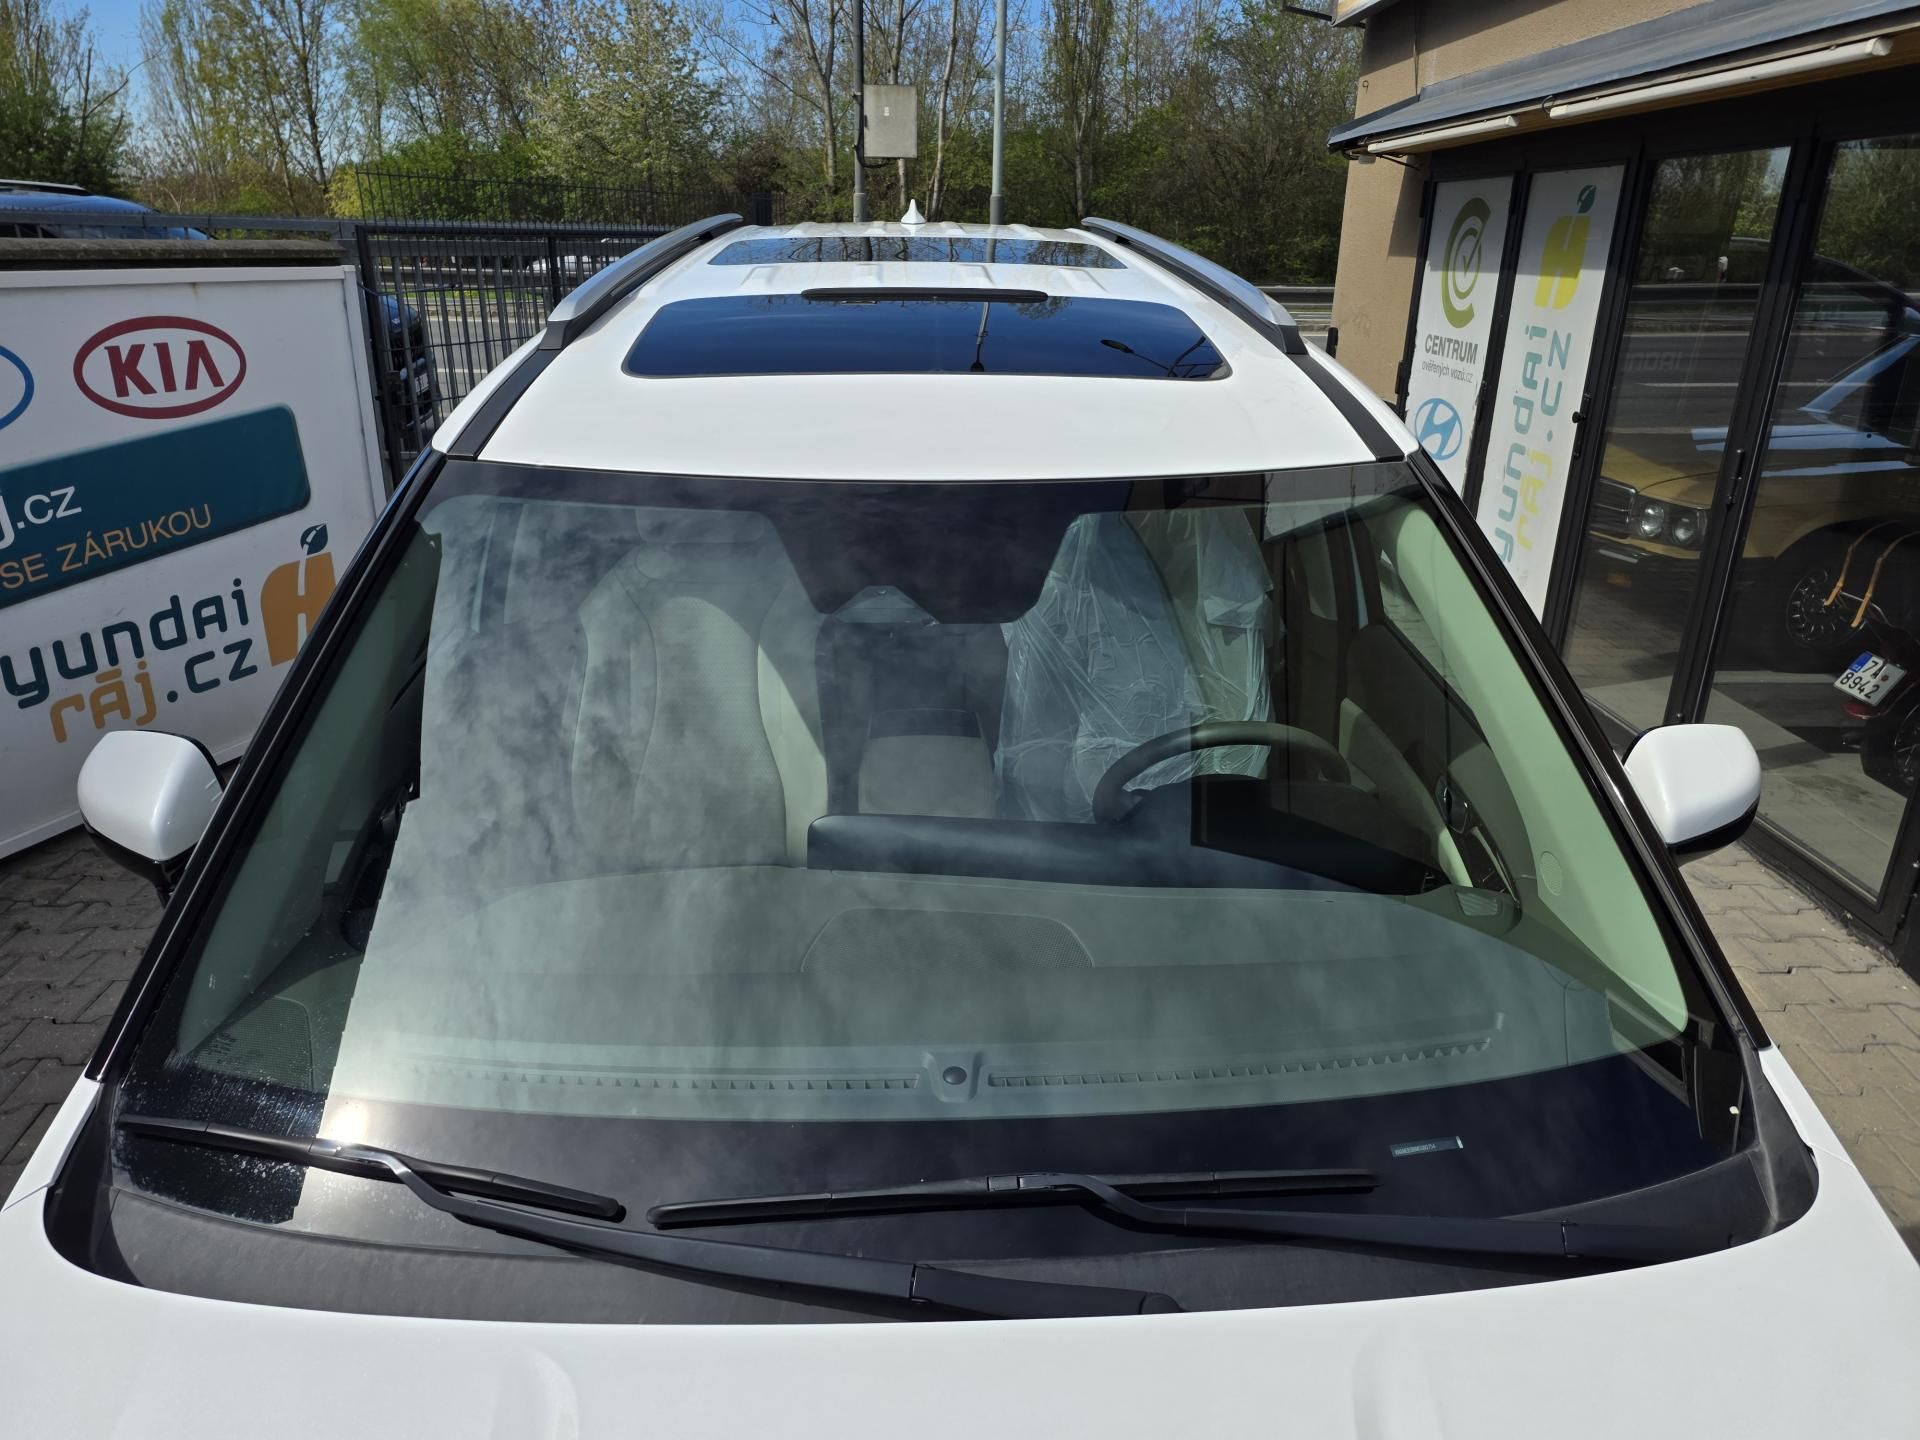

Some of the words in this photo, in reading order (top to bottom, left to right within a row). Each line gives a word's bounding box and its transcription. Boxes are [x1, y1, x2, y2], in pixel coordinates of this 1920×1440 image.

[104, 340, 225, 398] KIA
[1424, 334, 1478, 365] CENTRUM
[0, 553, 48, 589] SE
[56, 504, 212, 572] ZÁRUKOU
[1840, 672, 1880, 699] 8942
